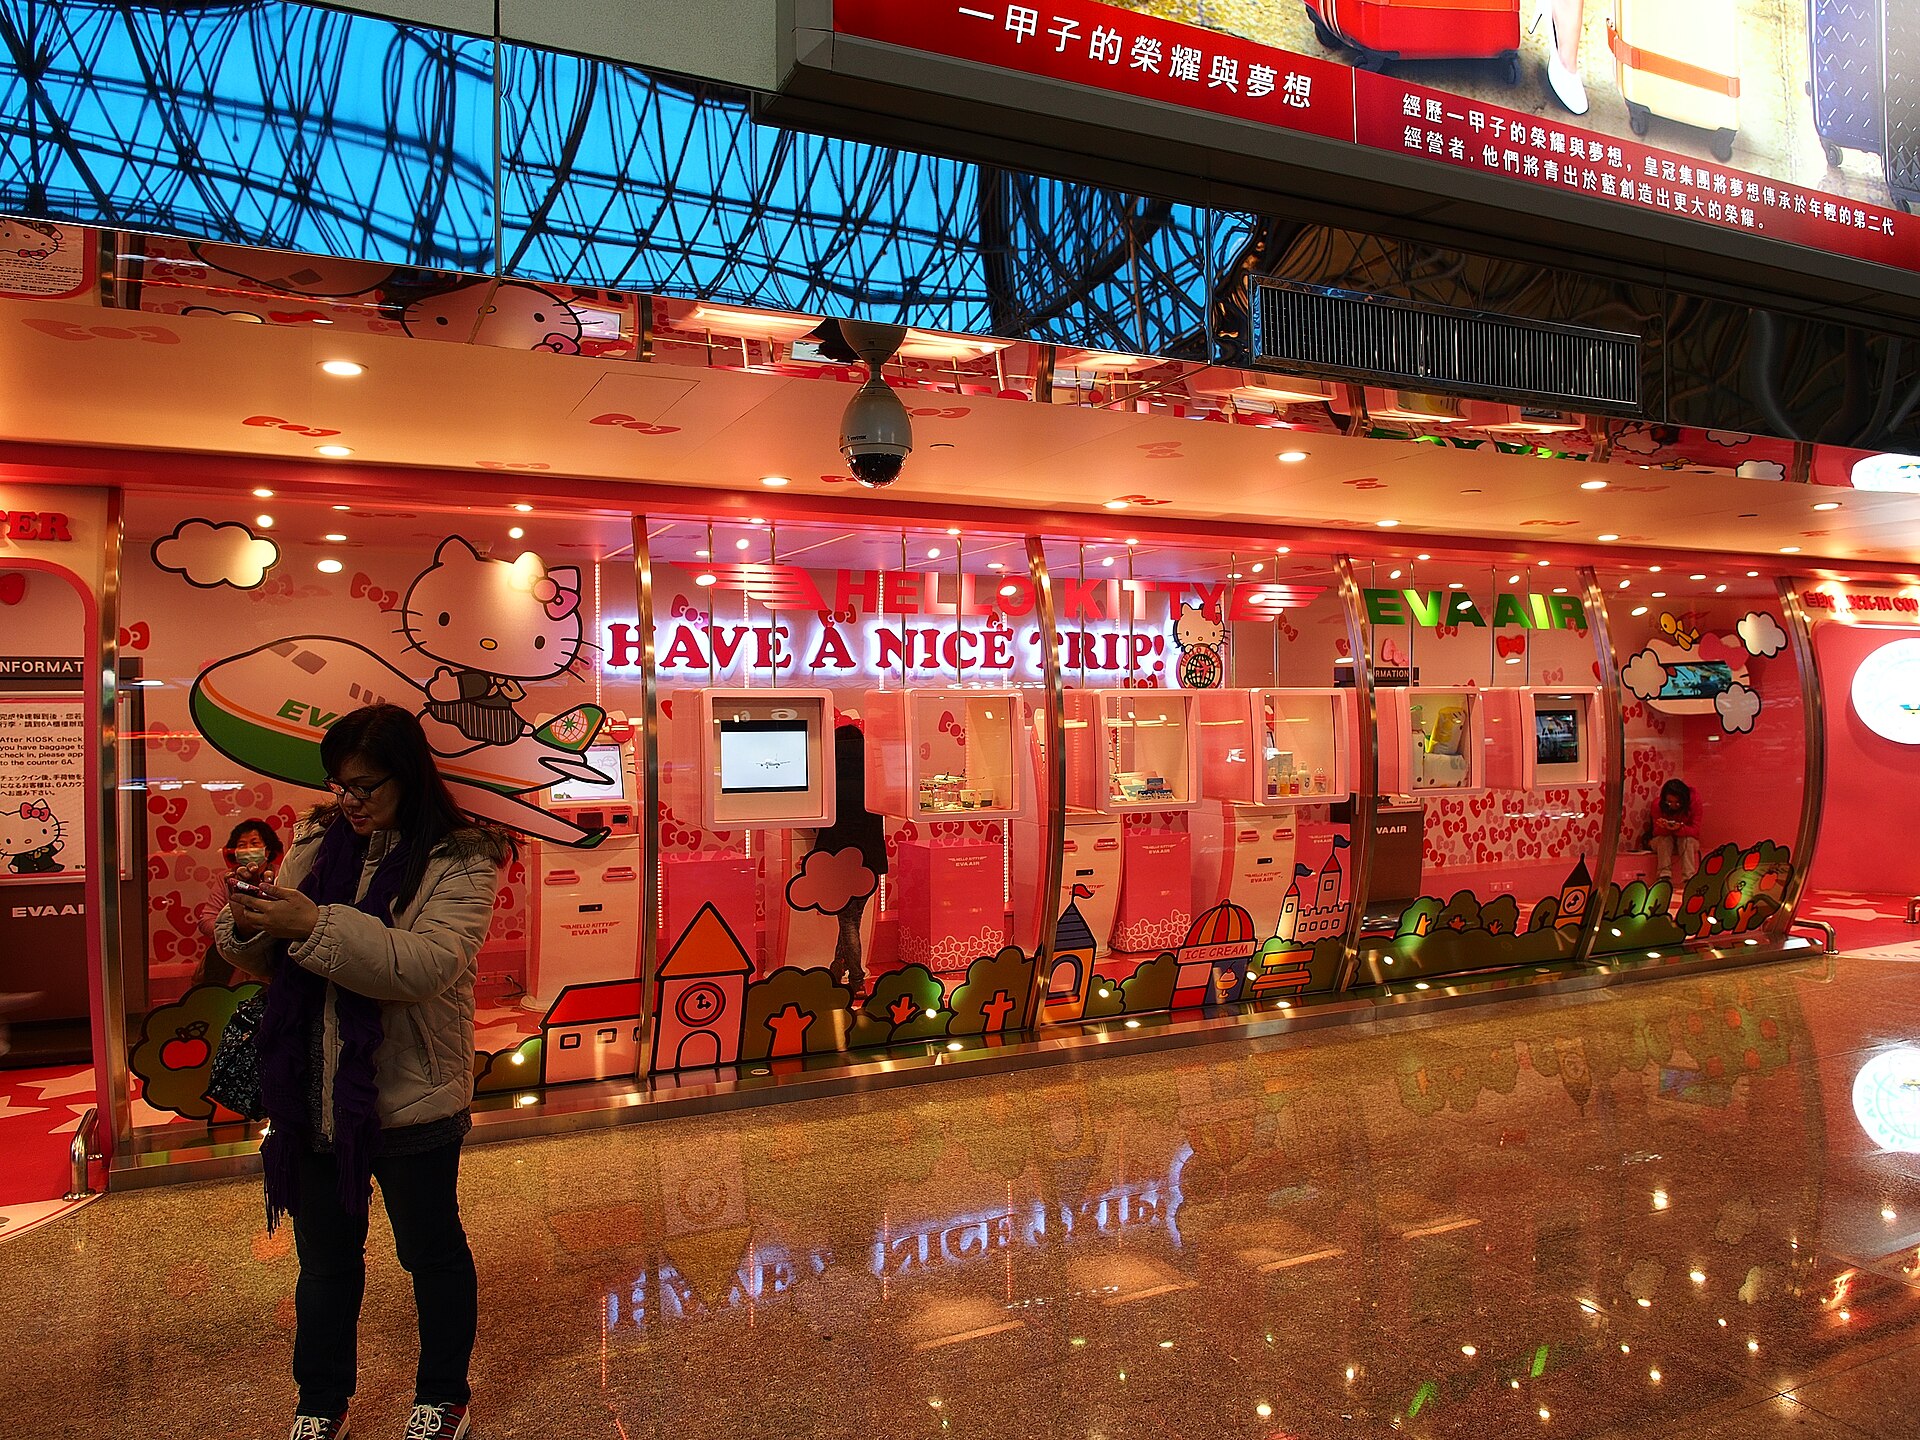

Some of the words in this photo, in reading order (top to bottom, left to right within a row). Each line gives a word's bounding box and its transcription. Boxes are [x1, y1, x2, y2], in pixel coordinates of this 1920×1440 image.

[958, 4, 1312, 109] 一甲子的榮耀與夢想
[836, 568, 1036, 616] HELLO
[1063, 577, 1227, 621] KITTY
[1363, 588, 1487, 627] EVA
[1493, 593, 1589, 630] AIR
[607, 621, 792, 669] HAVE
[808, 625, 857, 669] A
[874, 627, 1015, 670] NICE
[1029, 631, 1165, 672] TRIP!
[1374, 669, 1410, 678] RMATION
[1184, 948, 1206, 960] ICE
[1208, 944, 1248, 958] CREAM
